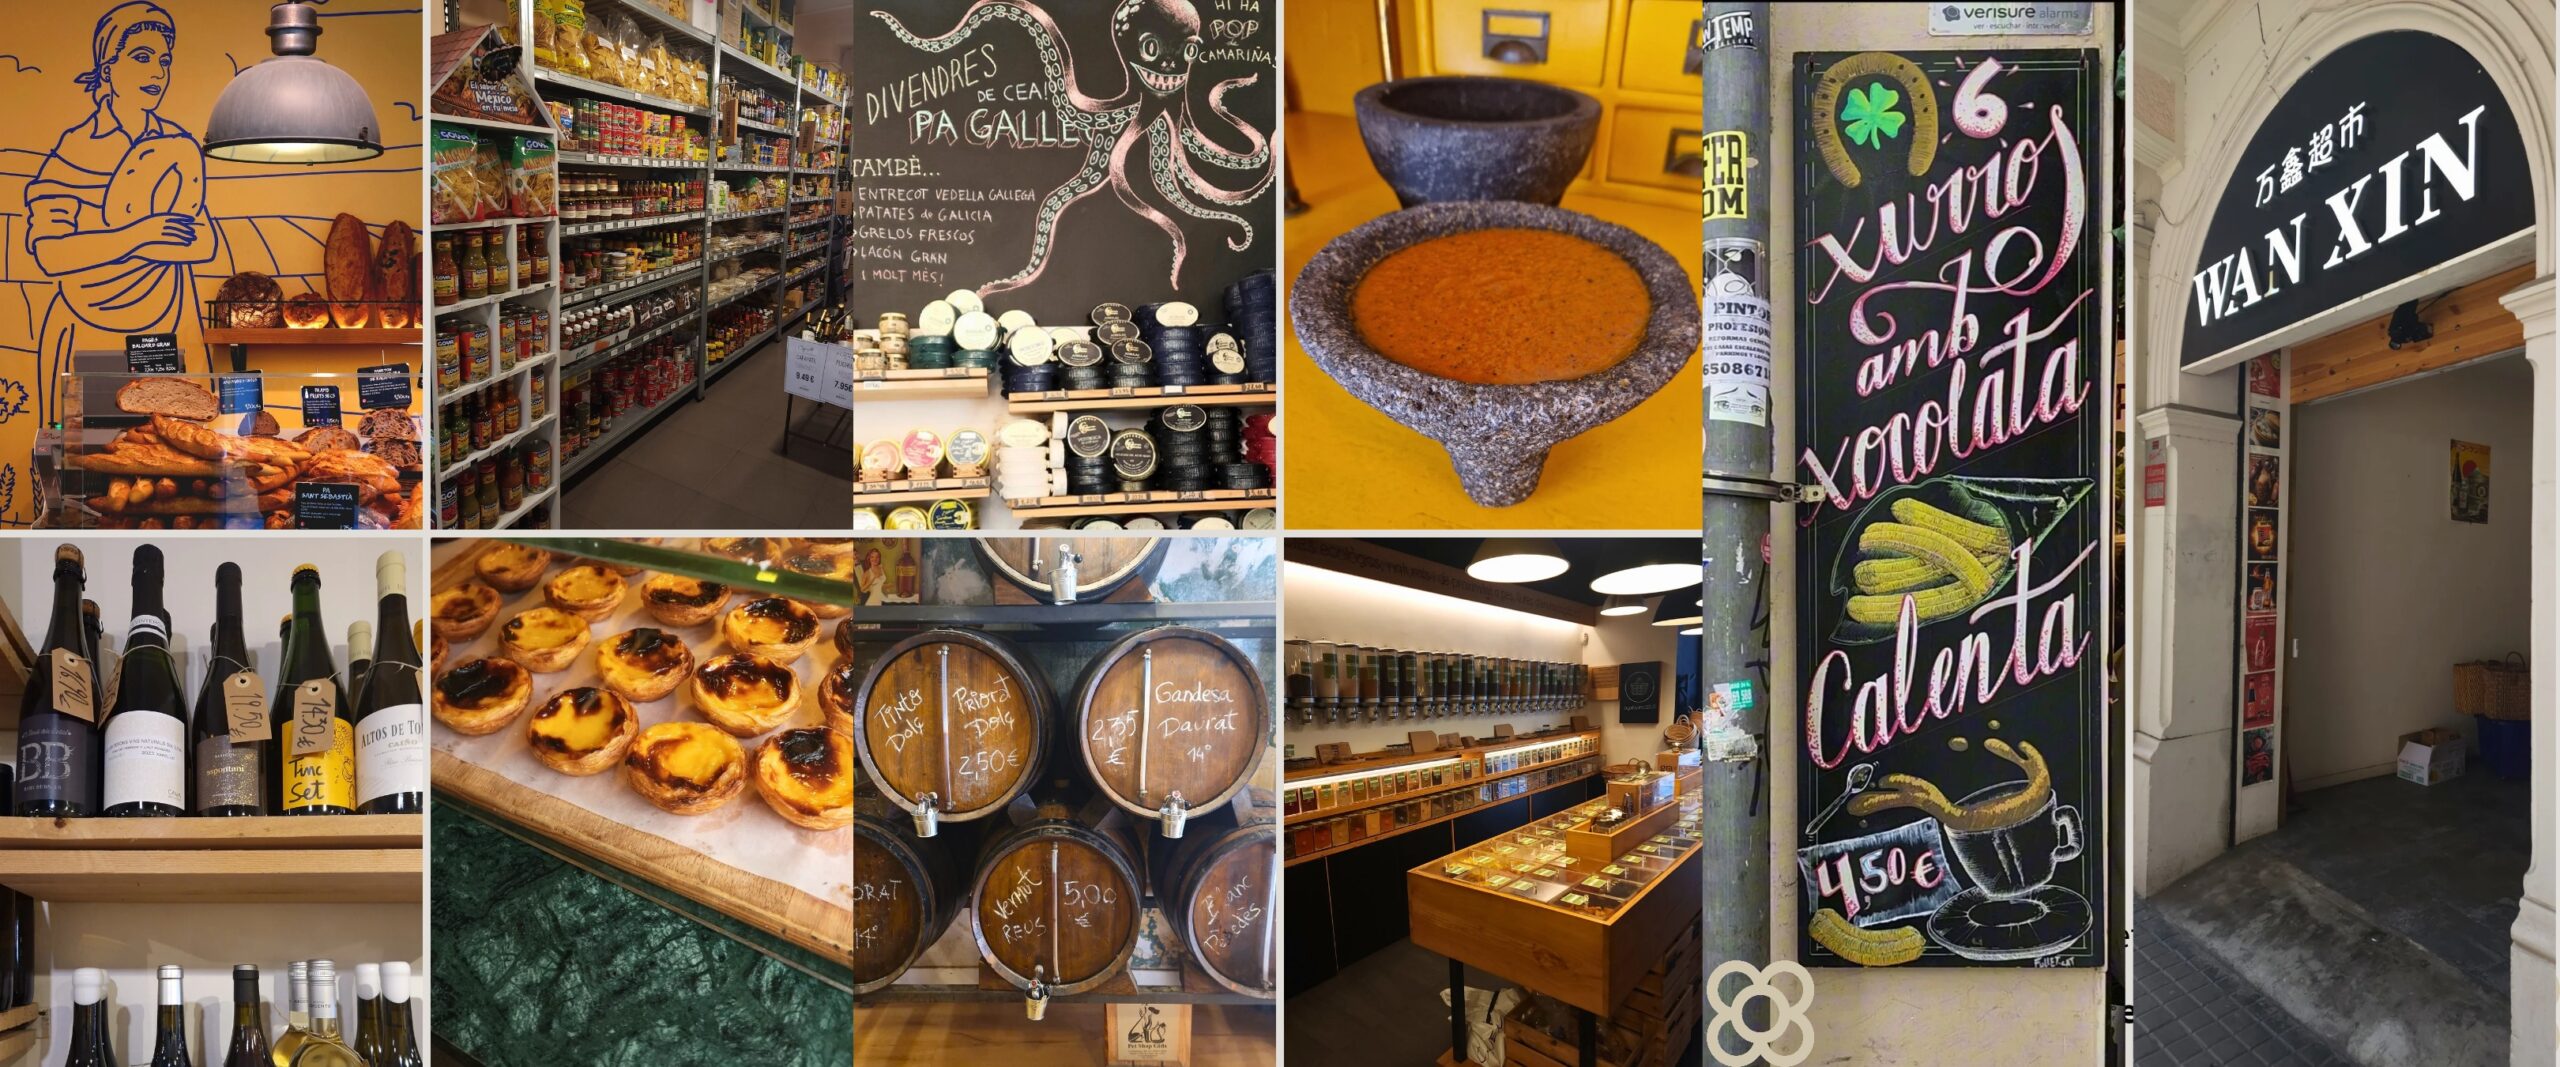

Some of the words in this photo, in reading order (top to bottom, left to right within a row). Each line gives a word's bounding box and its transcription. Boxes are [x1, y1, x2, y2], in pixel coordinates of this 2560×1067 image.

[1240, 0, 1260, 13] HA
[1963, 6, 2036, 19] verisure
[2039, 6, 2080, 19] alarms
[1209, 19, 1259, 40] POP
[1989, 22, 2021, 30] escuchar
[866, 44, 997, 125] DIVENDRES
[977, 88, 996, 103] DE
[475, 90, 512, 106] México
[1953, 56, 2008, 138] 6
[908, 109, 958, 146] PA
[2255, 101, 2366, 208] 万鑫超市
[859, 187, 929, 202] ENTRECOT
[936, 188, 985, 202] VEDELLA
[989, 188, 1036, 202] GALLEGA
[859, 205, 915, 221] PATATES
[938, 208, 993, 223] GALICIA
[2193, 212, 2306, 327] WAN
[2323, 105, 2485, 270] XIN
[859, 225, 913, 240] GRELOS
[919, 228, 976, 245] FRESCOS
[910, 250, 947, 264] GRAN
[873, 269, 907, 282] MOLT
[1800, 288, 2093, 527] xocolata
[1806, 537, 2098, 770] Calenta
[1155, 681, 1234, 703] Gandesa
[361, 728, 387, 750] ALTOS
[391, 721, 405, 737] DE
[1092, 710, 1139, 747] 2,35
[1105, 747, 1127, 765] €
[288, 756, 324, 779] Tinc
[289, 779, 325, 804] Set
[1816, 847, 1945, 919] 4,50€
[1002, 917, 1046, 945] REUS
